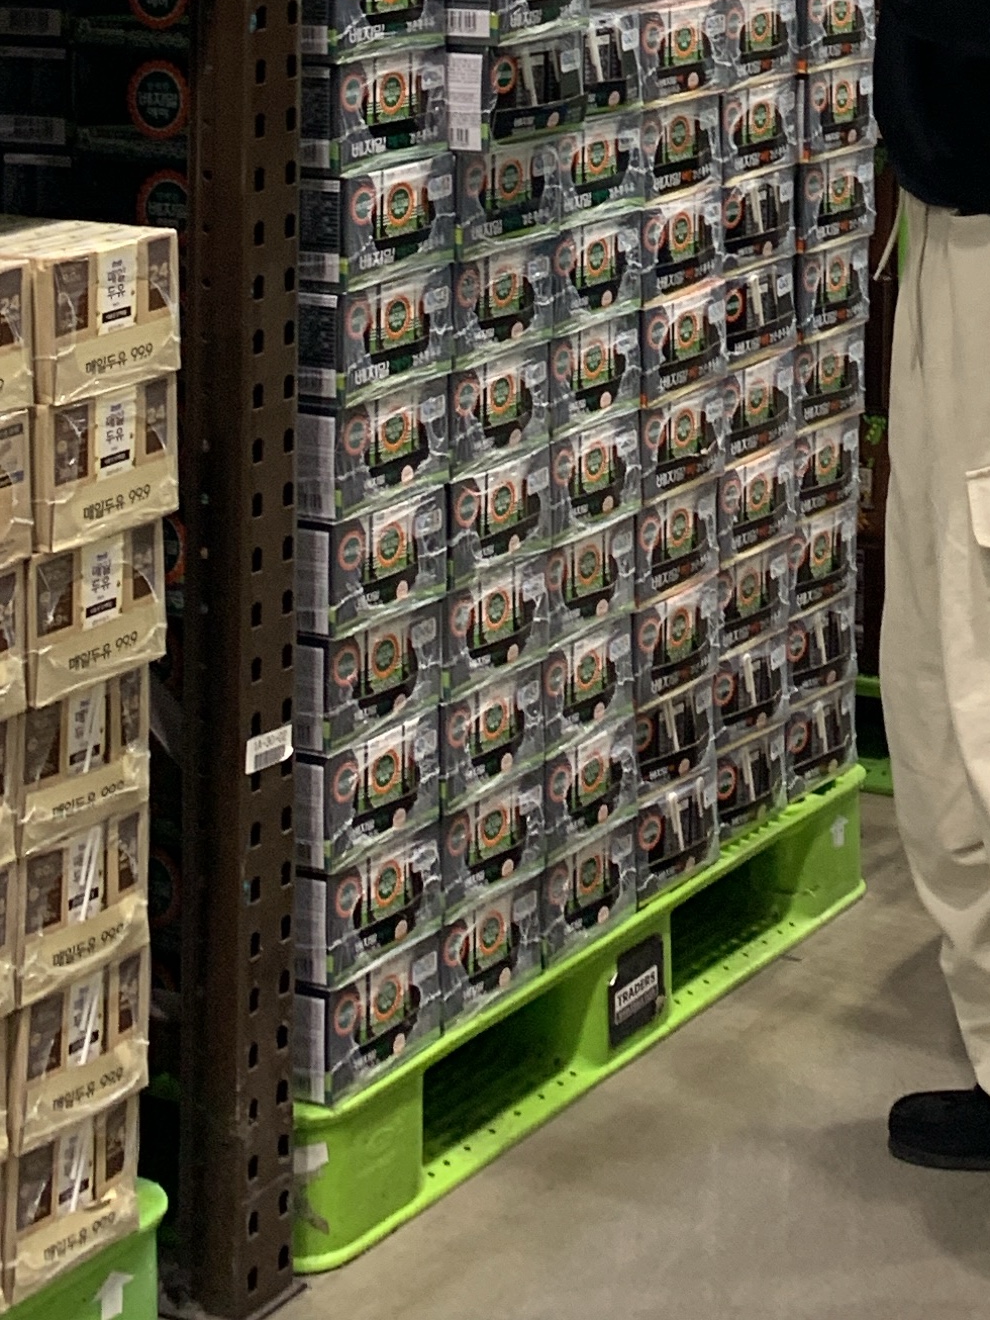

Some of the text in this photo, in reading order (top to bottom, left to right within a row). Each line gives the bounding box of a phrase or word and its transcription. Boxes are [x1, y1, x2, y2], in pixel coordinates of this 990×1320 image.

[349, 22, 386, 44] 베지밀
[351, 135, 387, 157] 베지밀
[653, 171, 682, 192] 베지밀
[563, 191, 593, 212] 베지밀
[358, 247, 396, 271] 베지밀
[150, 261, 170, 281] 24
[656, 272, 684, 291] 베지밀
[85, 350, 128, 375] 매일두유
[354, 360, 390, 385] 베지밀
[658, 372, 688, 393] 베지밀
[655, 466, 685, 488] 베지밀
[83, 493, 126, 521] 매일두유
[68, 642, 112, 670] 매일두유
[52, 935, 97, 967] 매일두유
[616, 970, 656, 1008] TRADERS
[52, 1079, 96, 1110] 매일두유
